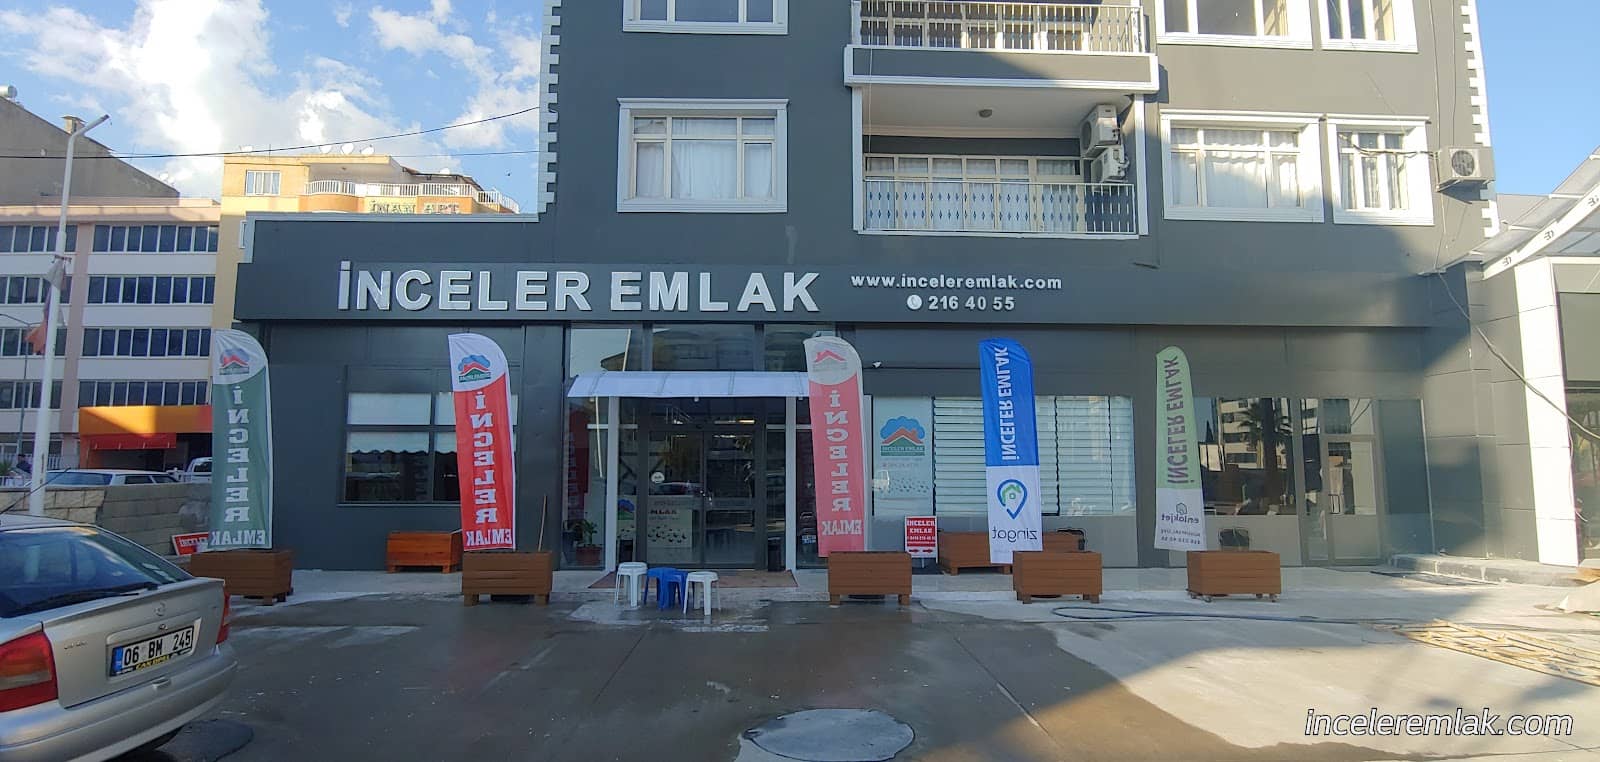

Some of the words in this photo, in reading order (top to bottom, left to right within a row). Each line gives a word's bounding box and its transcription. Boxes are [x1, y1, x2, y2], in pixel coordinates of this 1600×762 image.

[338, 260, 592, 312] İNCELER
[610, 271, 820, 312] EMLAK
[851, 273, 1062, 289] www.inceleremlak.com
[928, 296, 959, 310] 216
[965, 296, 987, 310] 40
[993, 296, 1015, 310] 55
[124, 646, 140, 666] 06
[148, 638, 163, 658] BM
[173, 630, 191, 650] 245
